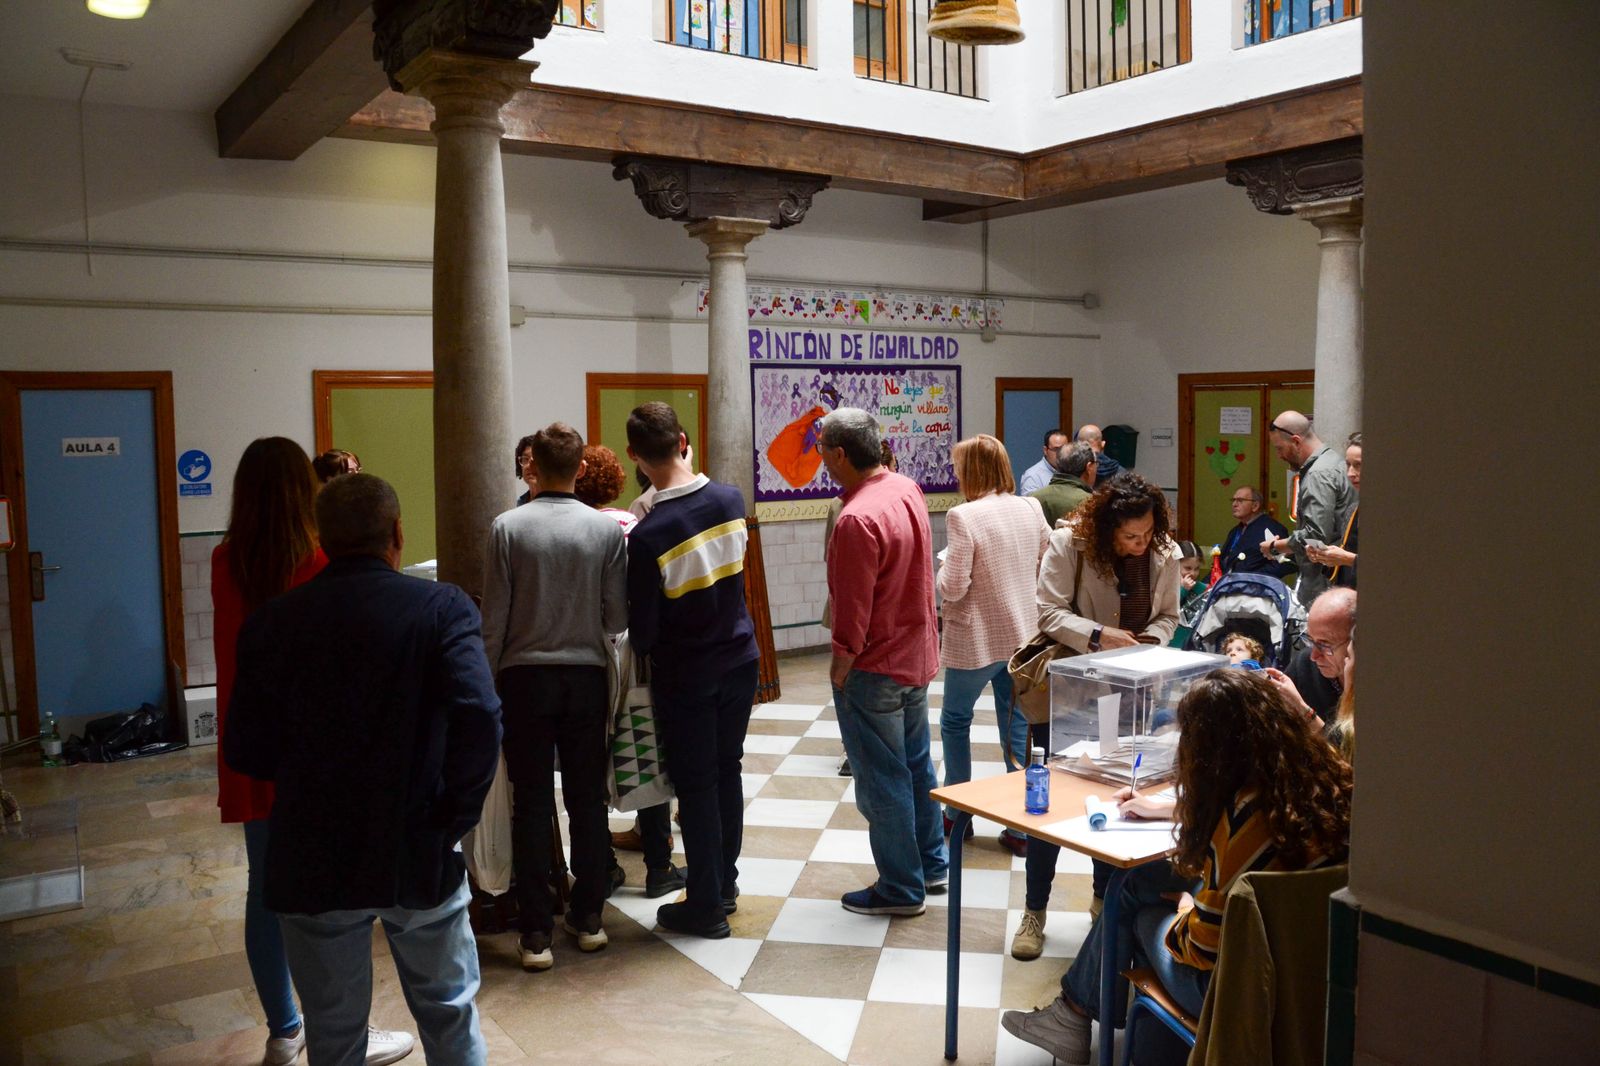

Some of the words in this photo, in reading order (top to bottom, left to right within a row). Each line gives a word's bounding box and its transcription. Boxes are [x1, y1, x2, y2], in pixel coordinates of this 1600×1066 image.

[841, 334, 863, 360] DE
[869, 332, 959, 359] IGUALDAD
[884, 378, 900, 395] No
[903, 380, 924, 401] dejes
[929, 385, 944, 399] que
[880, 402, 912, 420] ningún
[917, 401, 949, 414] villano
[912, 420, 923, 433] la
[925, 422, 951, 437] capa
[65, 443, 103, 453] AULA
[107, 443, 115, 453] 4
